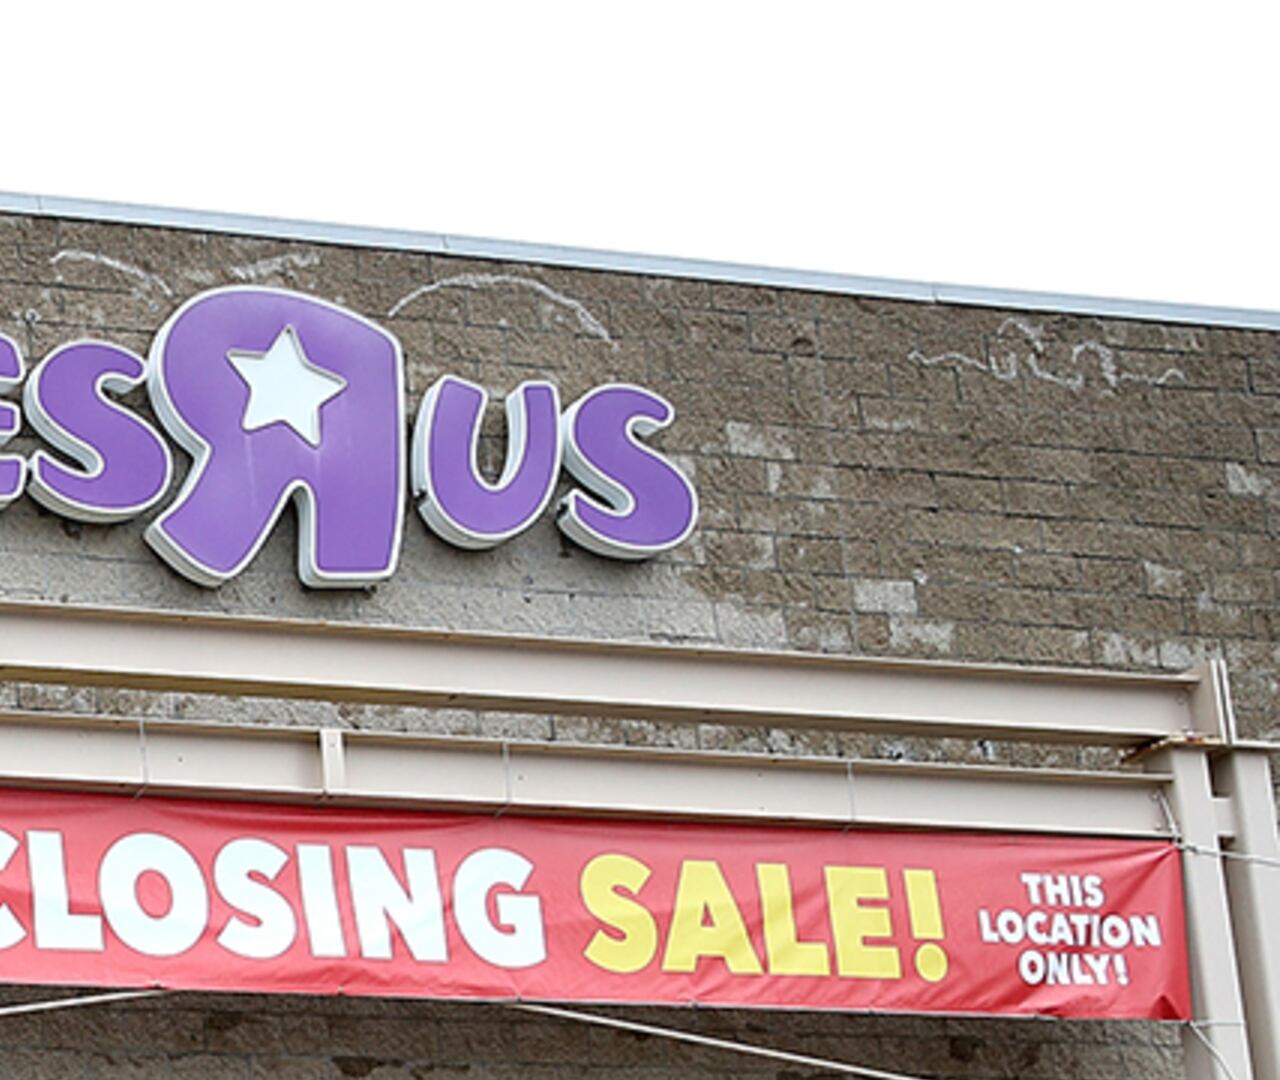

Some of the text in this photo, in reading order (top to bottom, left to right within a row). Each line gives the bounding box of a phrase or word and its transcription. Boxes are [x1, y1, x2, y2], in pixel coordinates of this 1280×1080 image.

[1020, 872, 1106, 908] THIS
[578, 850, 948, 985] SALE!
[978, 909, 1163, 948] LOCATION
[1018, 948, 1130, 986] ONLY!
